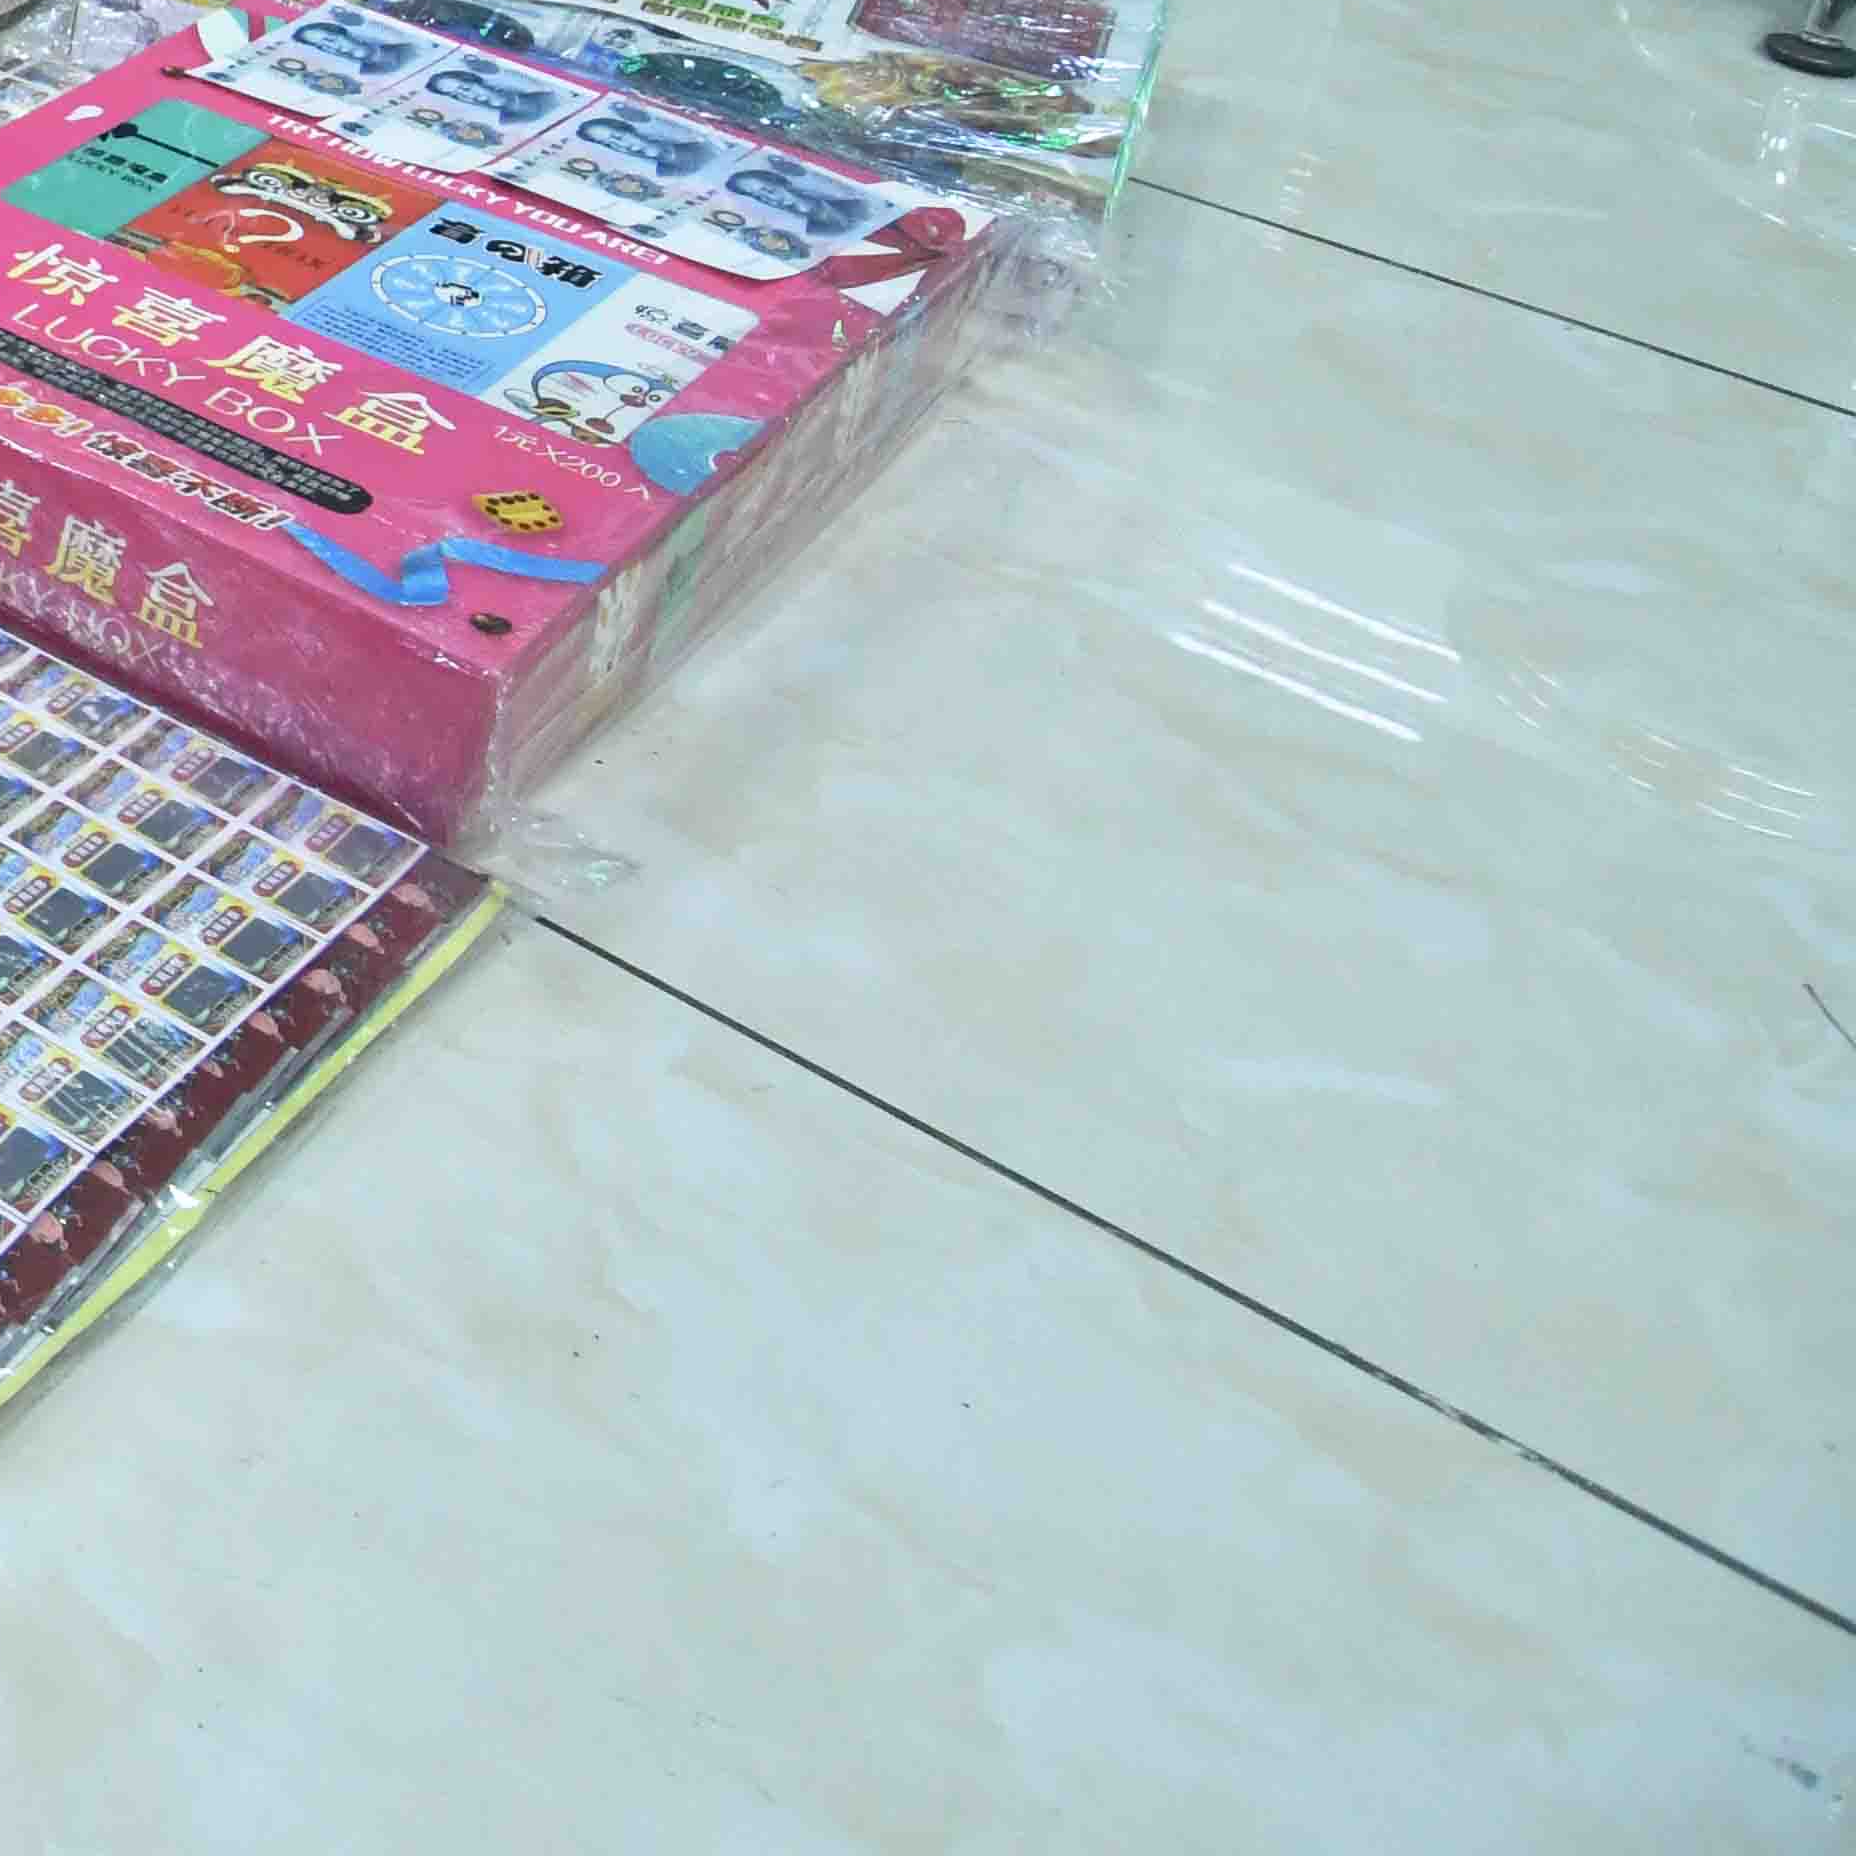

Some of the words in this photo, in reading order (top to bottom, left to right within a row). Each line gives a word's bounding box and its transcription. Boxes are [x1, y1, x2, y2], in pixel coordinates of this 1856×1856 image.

[268, 114, 328, 146] TRY
[392, 165, 508, 210] LUCKY
[512, 200, 586, 237] YOU
[6, 243, 456, 455] 惊喜魔盒
[13, 304, 206, 387] LUCKY
[207, 387, 342, 456] BOX
